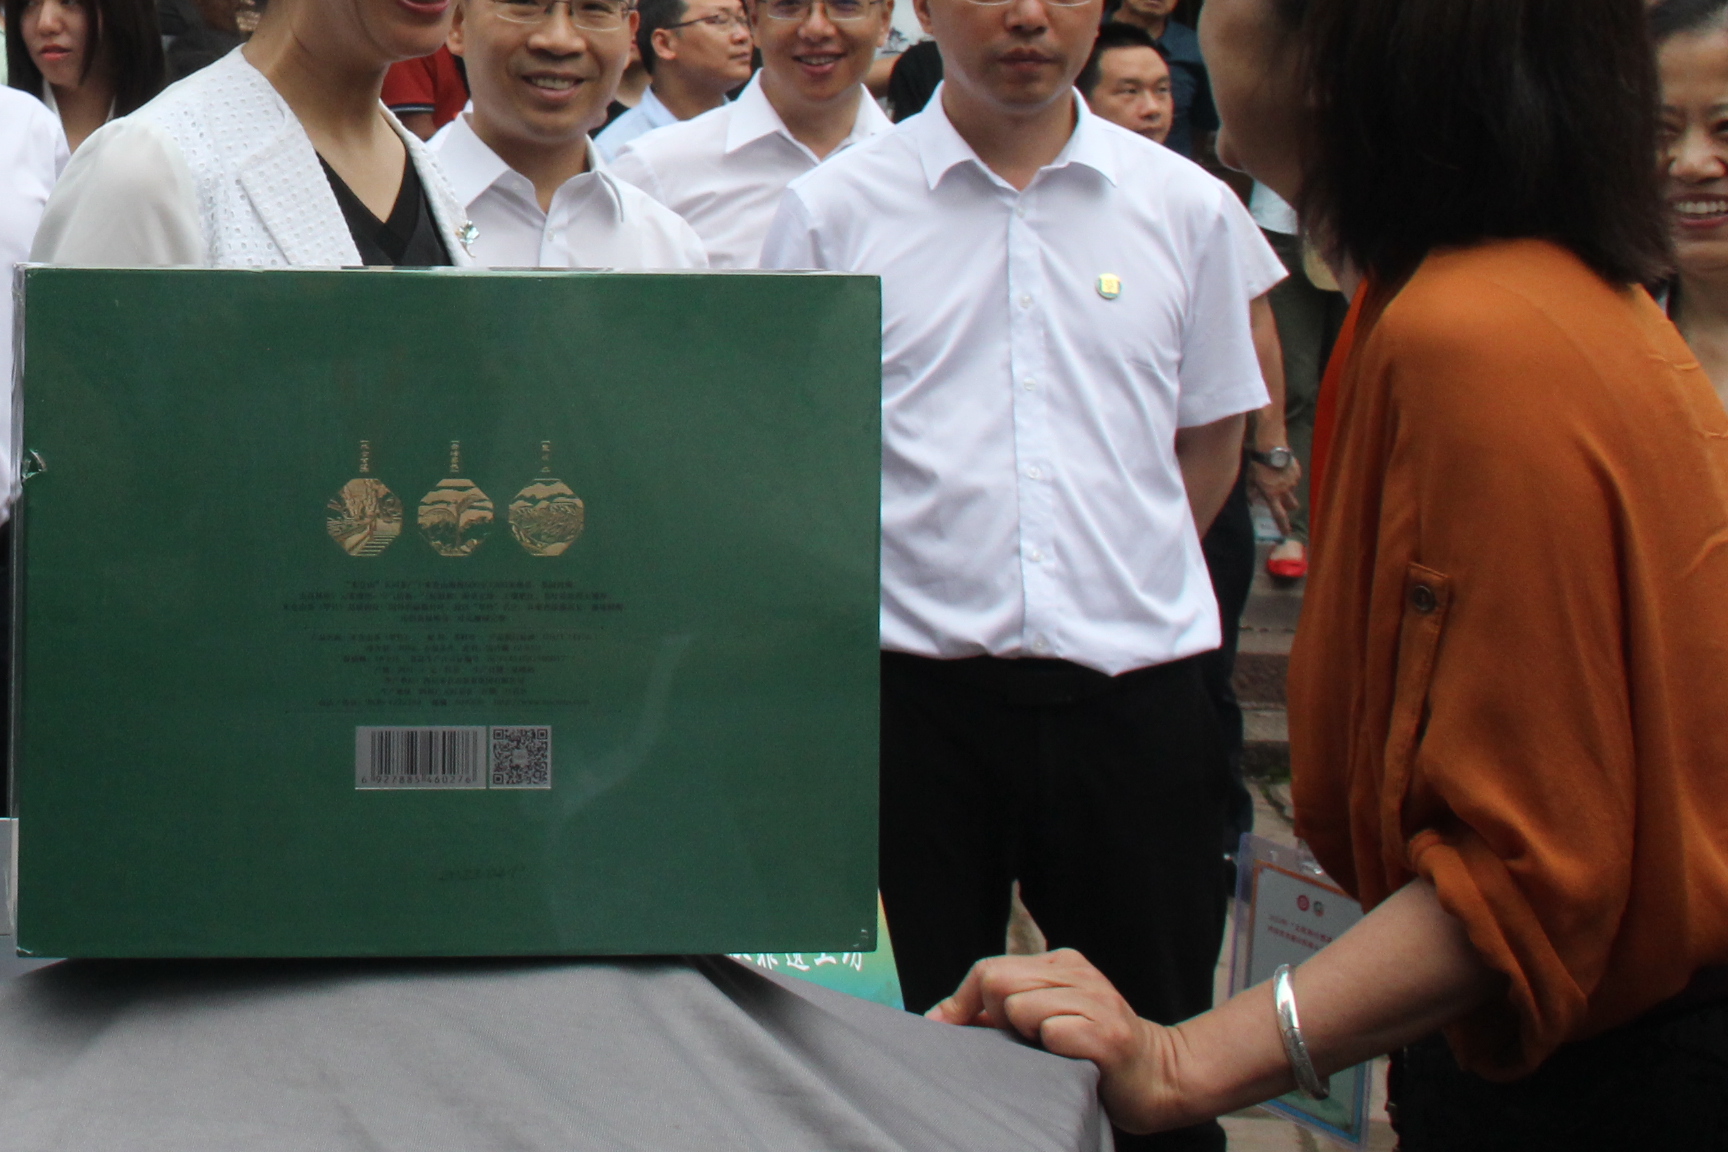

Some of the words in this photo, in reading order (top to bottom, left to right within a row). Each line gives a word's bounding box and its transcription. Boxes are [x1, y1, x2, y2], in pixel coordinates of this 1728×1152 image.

[361, 776, 368, 784] 6
[376, 775, 421, 784] 927885
[427, 775, 472, 784] 460276
